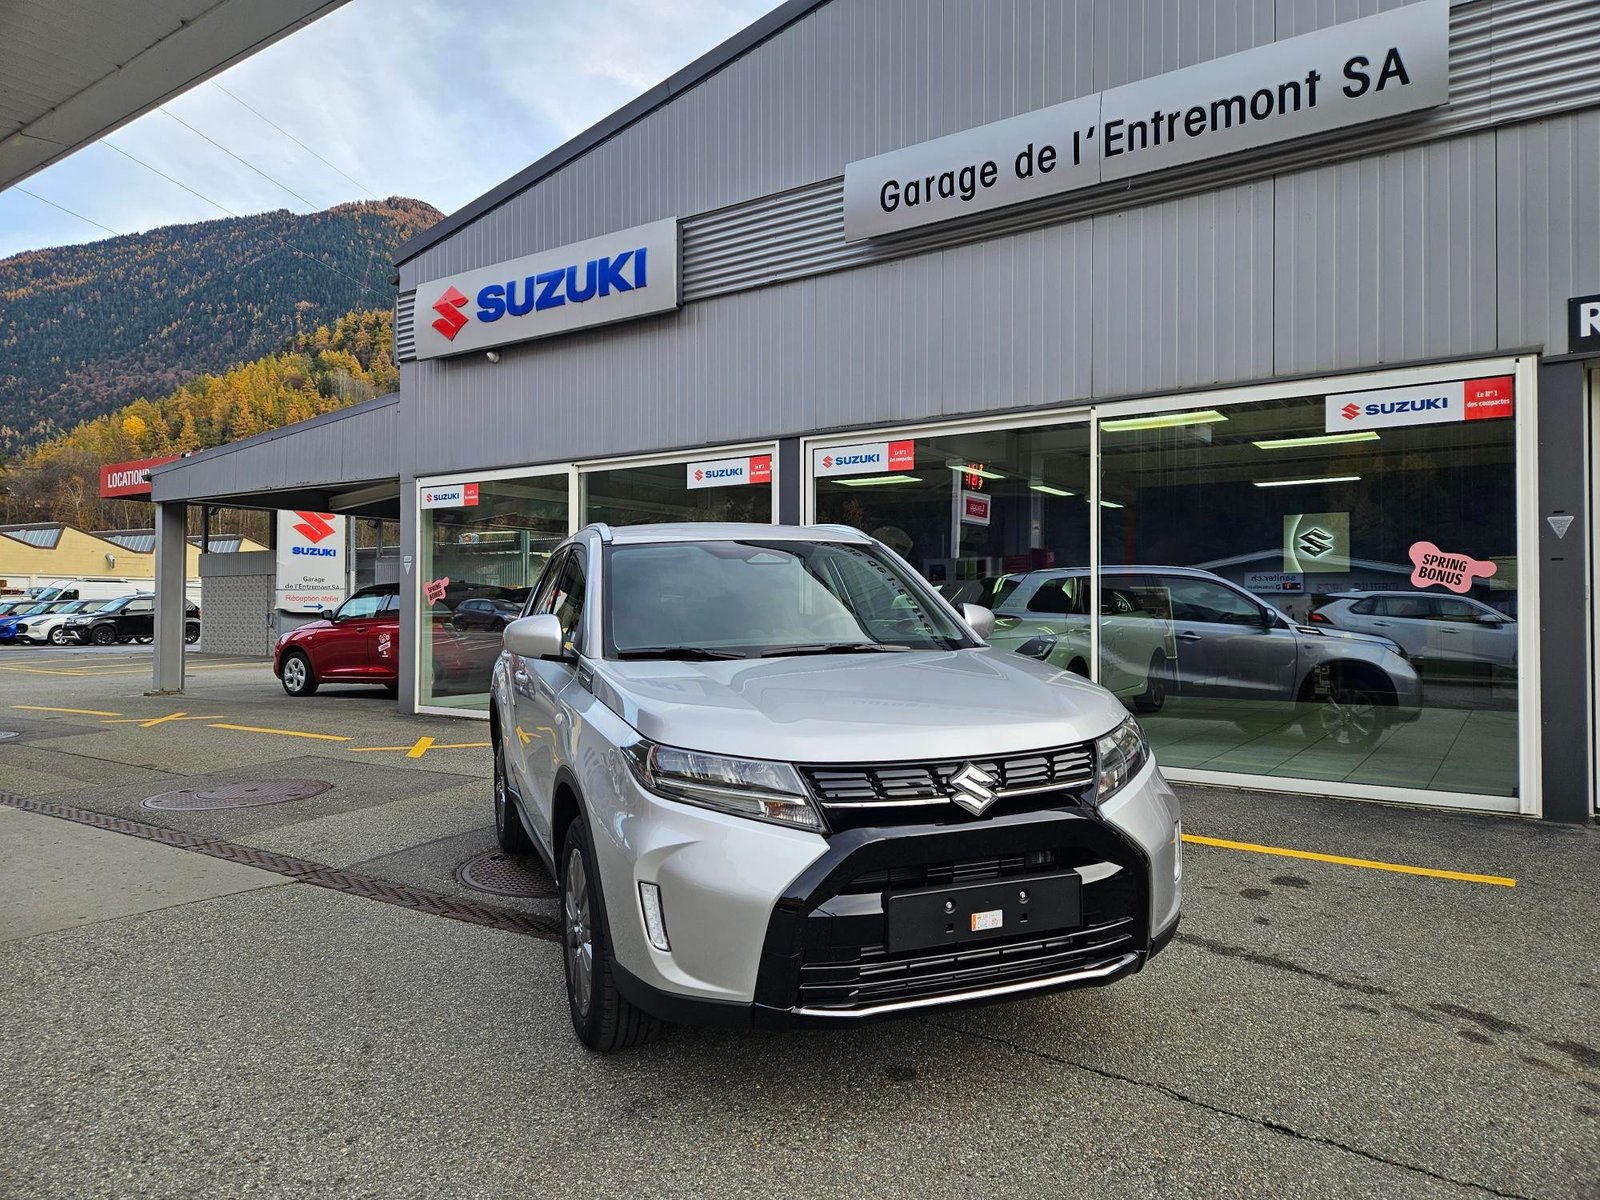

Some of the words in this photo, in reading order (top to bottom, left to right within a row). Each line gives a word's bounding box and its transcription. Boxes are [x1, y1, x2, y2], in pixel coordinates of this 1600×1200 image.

[879, 157, 998, 214] Garage
[1014, 143, 1057, 180] de
[1072, 70, 1321, 167] l'Entremont
[1342, 47, 1411, 98] SA
[476, 247, 648, 323] SUZUKI
[1365, 397, 1448, 416] SUZUKI
[1479, 398, 1510, 407] compactes
[835, 453, 880, 466] SUZUKI
[705, 467, 743, 479] SUZUKI
[433, 492, 460, 501] SUZUKI
[292, 546, 337, 557] SUZUKI
[1422, 553, 1467, 572] SPRING
[303, 575, 325, 583] Garage
[1418, 566, 1463, 586] BONUS
[427, 582, 441, 593] SPRING
[285, 593, 320, 603] Réception
